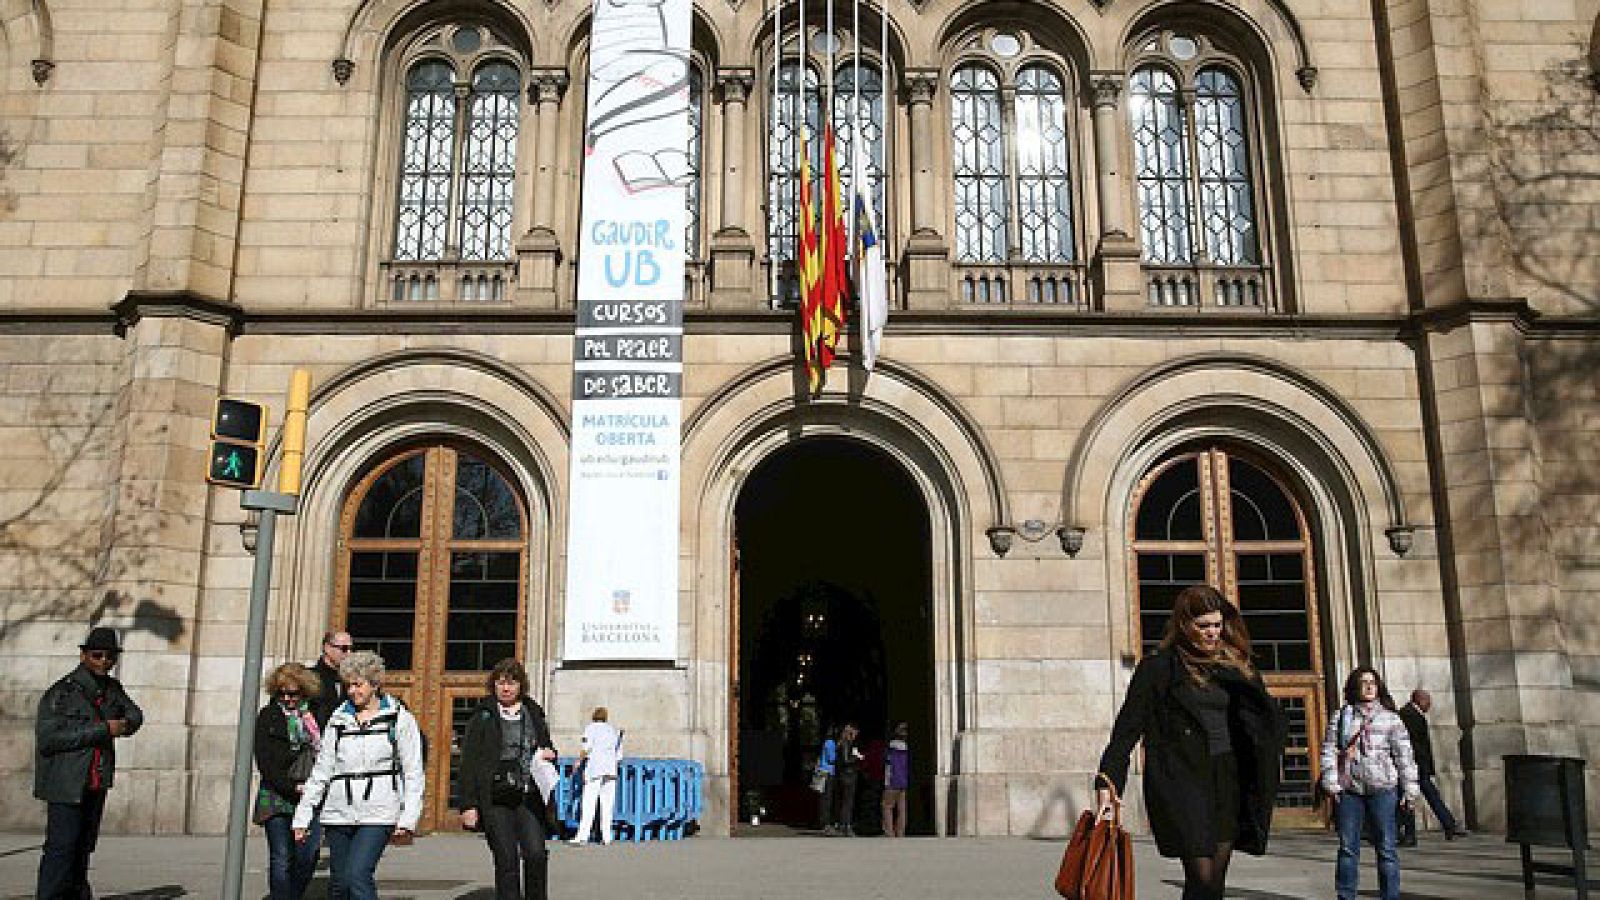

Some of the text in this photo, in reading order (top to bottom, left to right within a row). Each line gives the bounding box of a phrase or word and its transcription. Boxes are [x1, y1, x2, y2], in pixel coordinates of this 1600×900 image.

[604, 249, 661, 287] UB
[592, 302, 668, 324] CURSOS
[595, 432, 656, 446] OBERTA
[582, 632, 660, 643] BARCELONA
